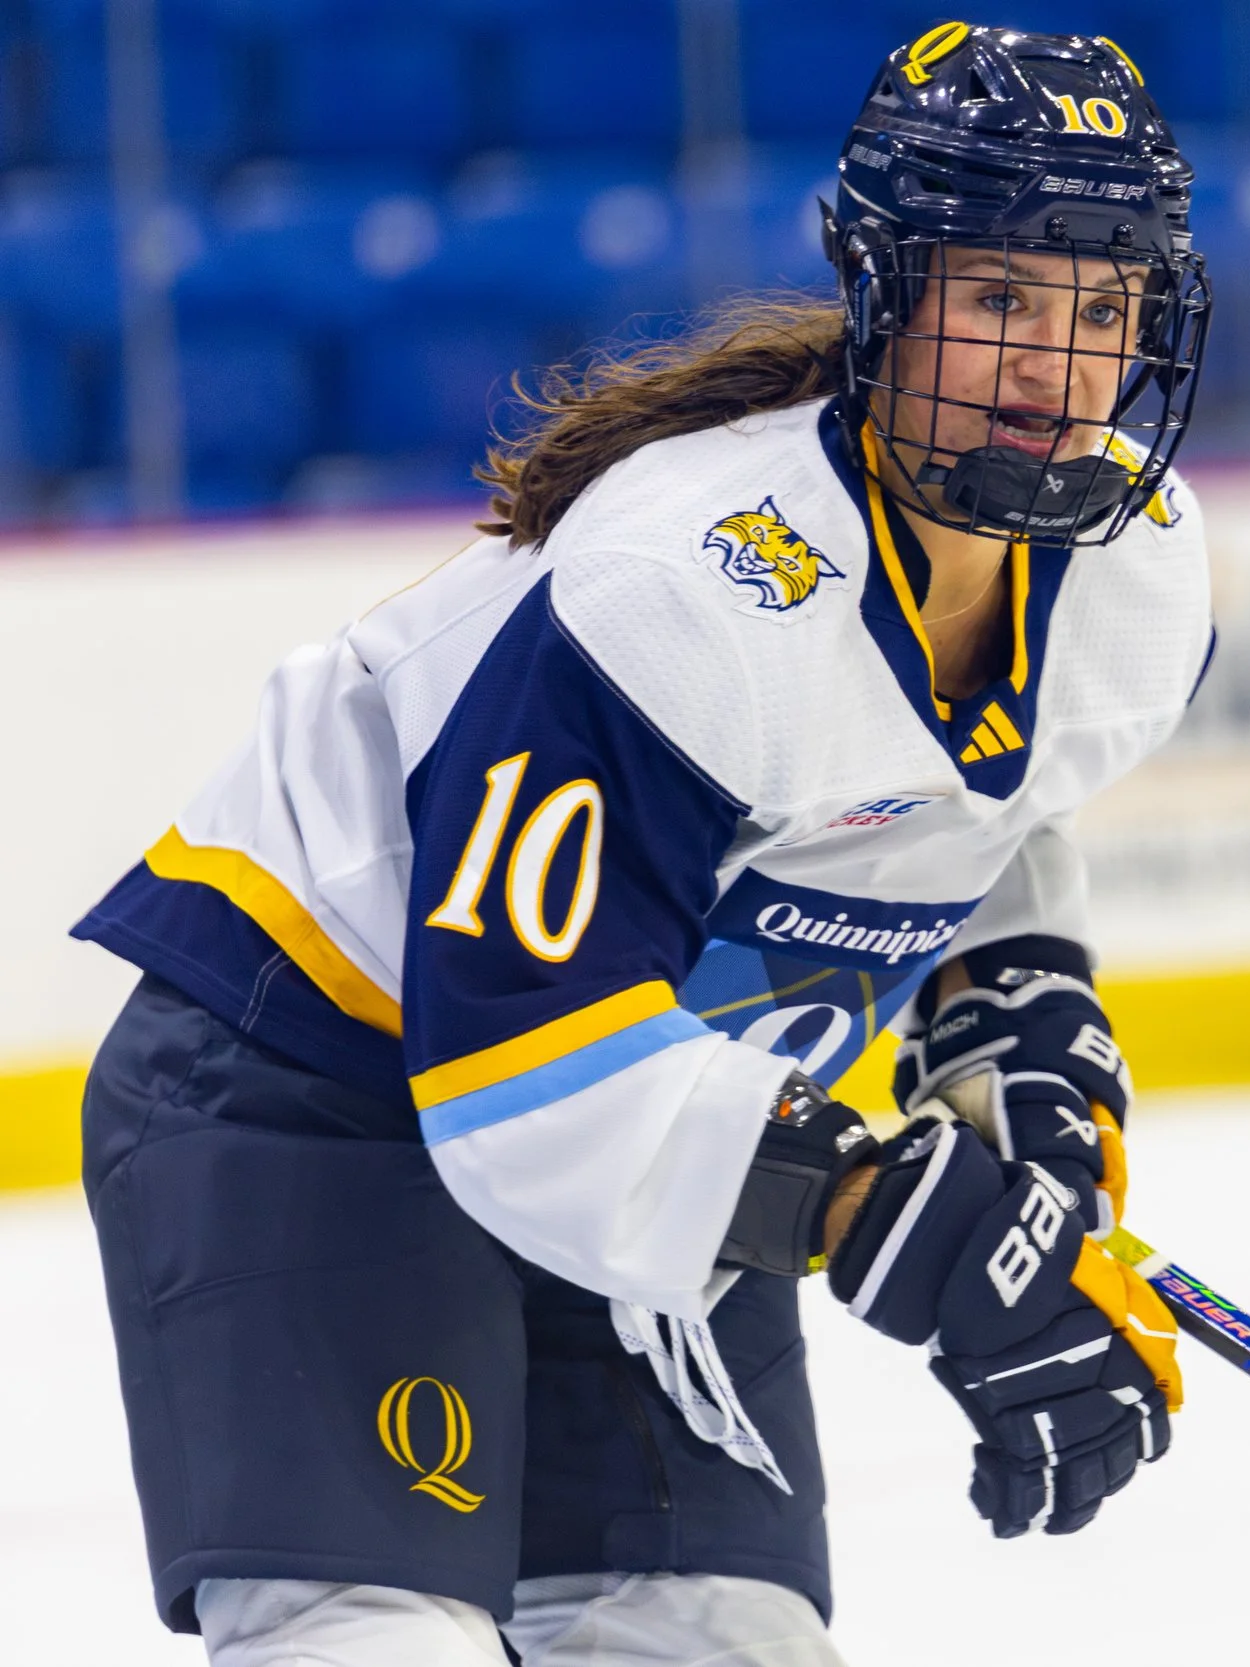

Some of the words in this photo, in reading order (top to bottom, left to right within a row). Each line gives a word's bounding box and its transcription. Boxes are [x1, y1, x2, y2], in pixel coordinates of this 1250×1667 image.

[901, 21, 969, 86] Q
[1053, 94, 1127, 138] 10
[1039, 175, 1147, 201] BAUER
[424, 751, 604, 964] 10
[377, 1376, 486, 1513] Q
